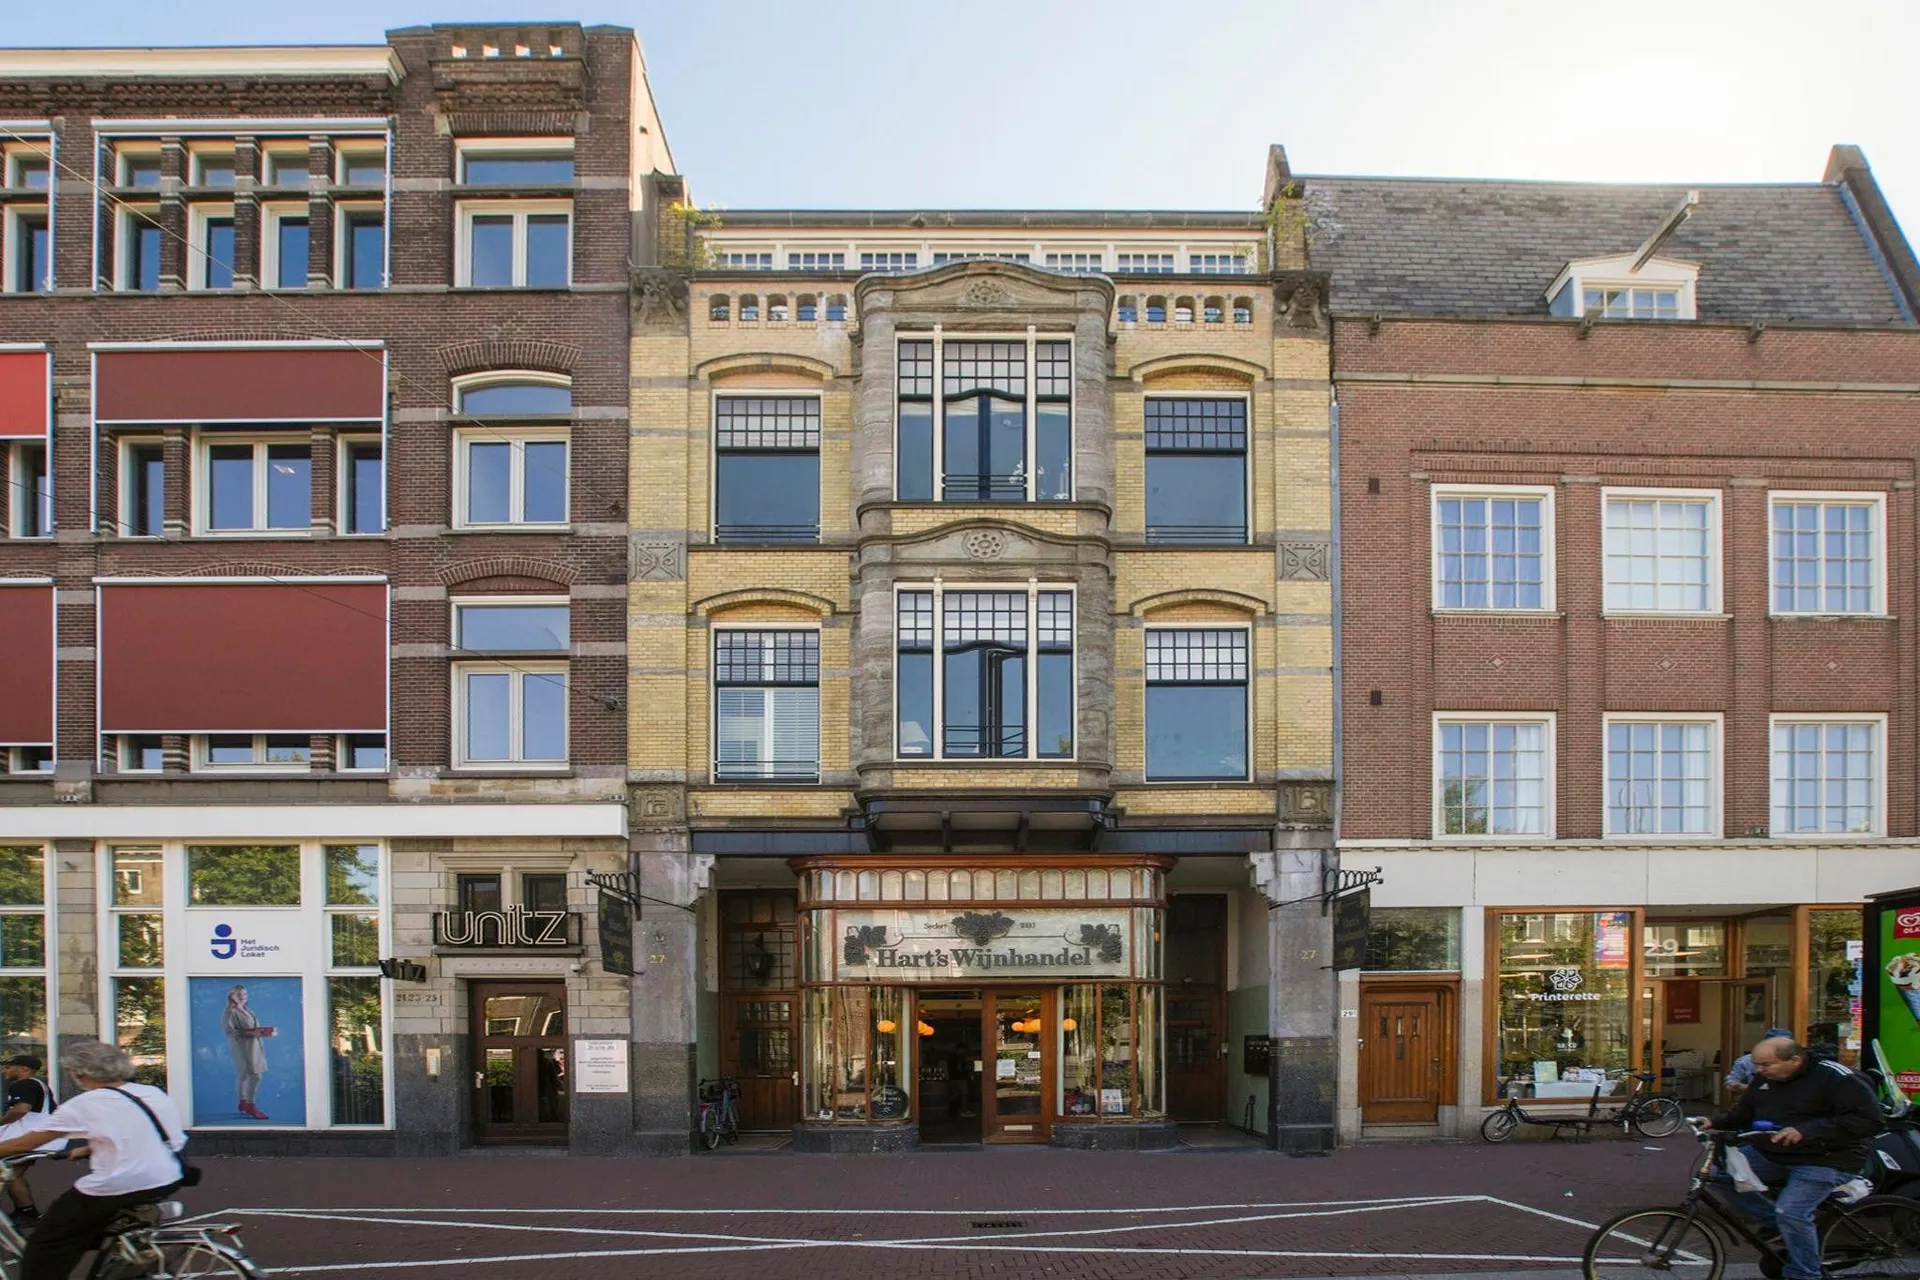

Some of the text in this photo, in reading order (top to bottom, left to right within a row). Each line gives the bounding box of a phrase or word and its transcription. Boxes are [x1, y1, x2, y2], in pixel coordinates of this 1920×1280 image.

[441, 904, 567, 945] unitz
[1300, 949, 1317, 960] 27
[1644, 938, 1679, 957] 29
[649, 954, 665, 964] 27
[875, 947, 1092, 970] Hart's Wijnhandel
[1530, 992, 1601, 1001] Printerette
